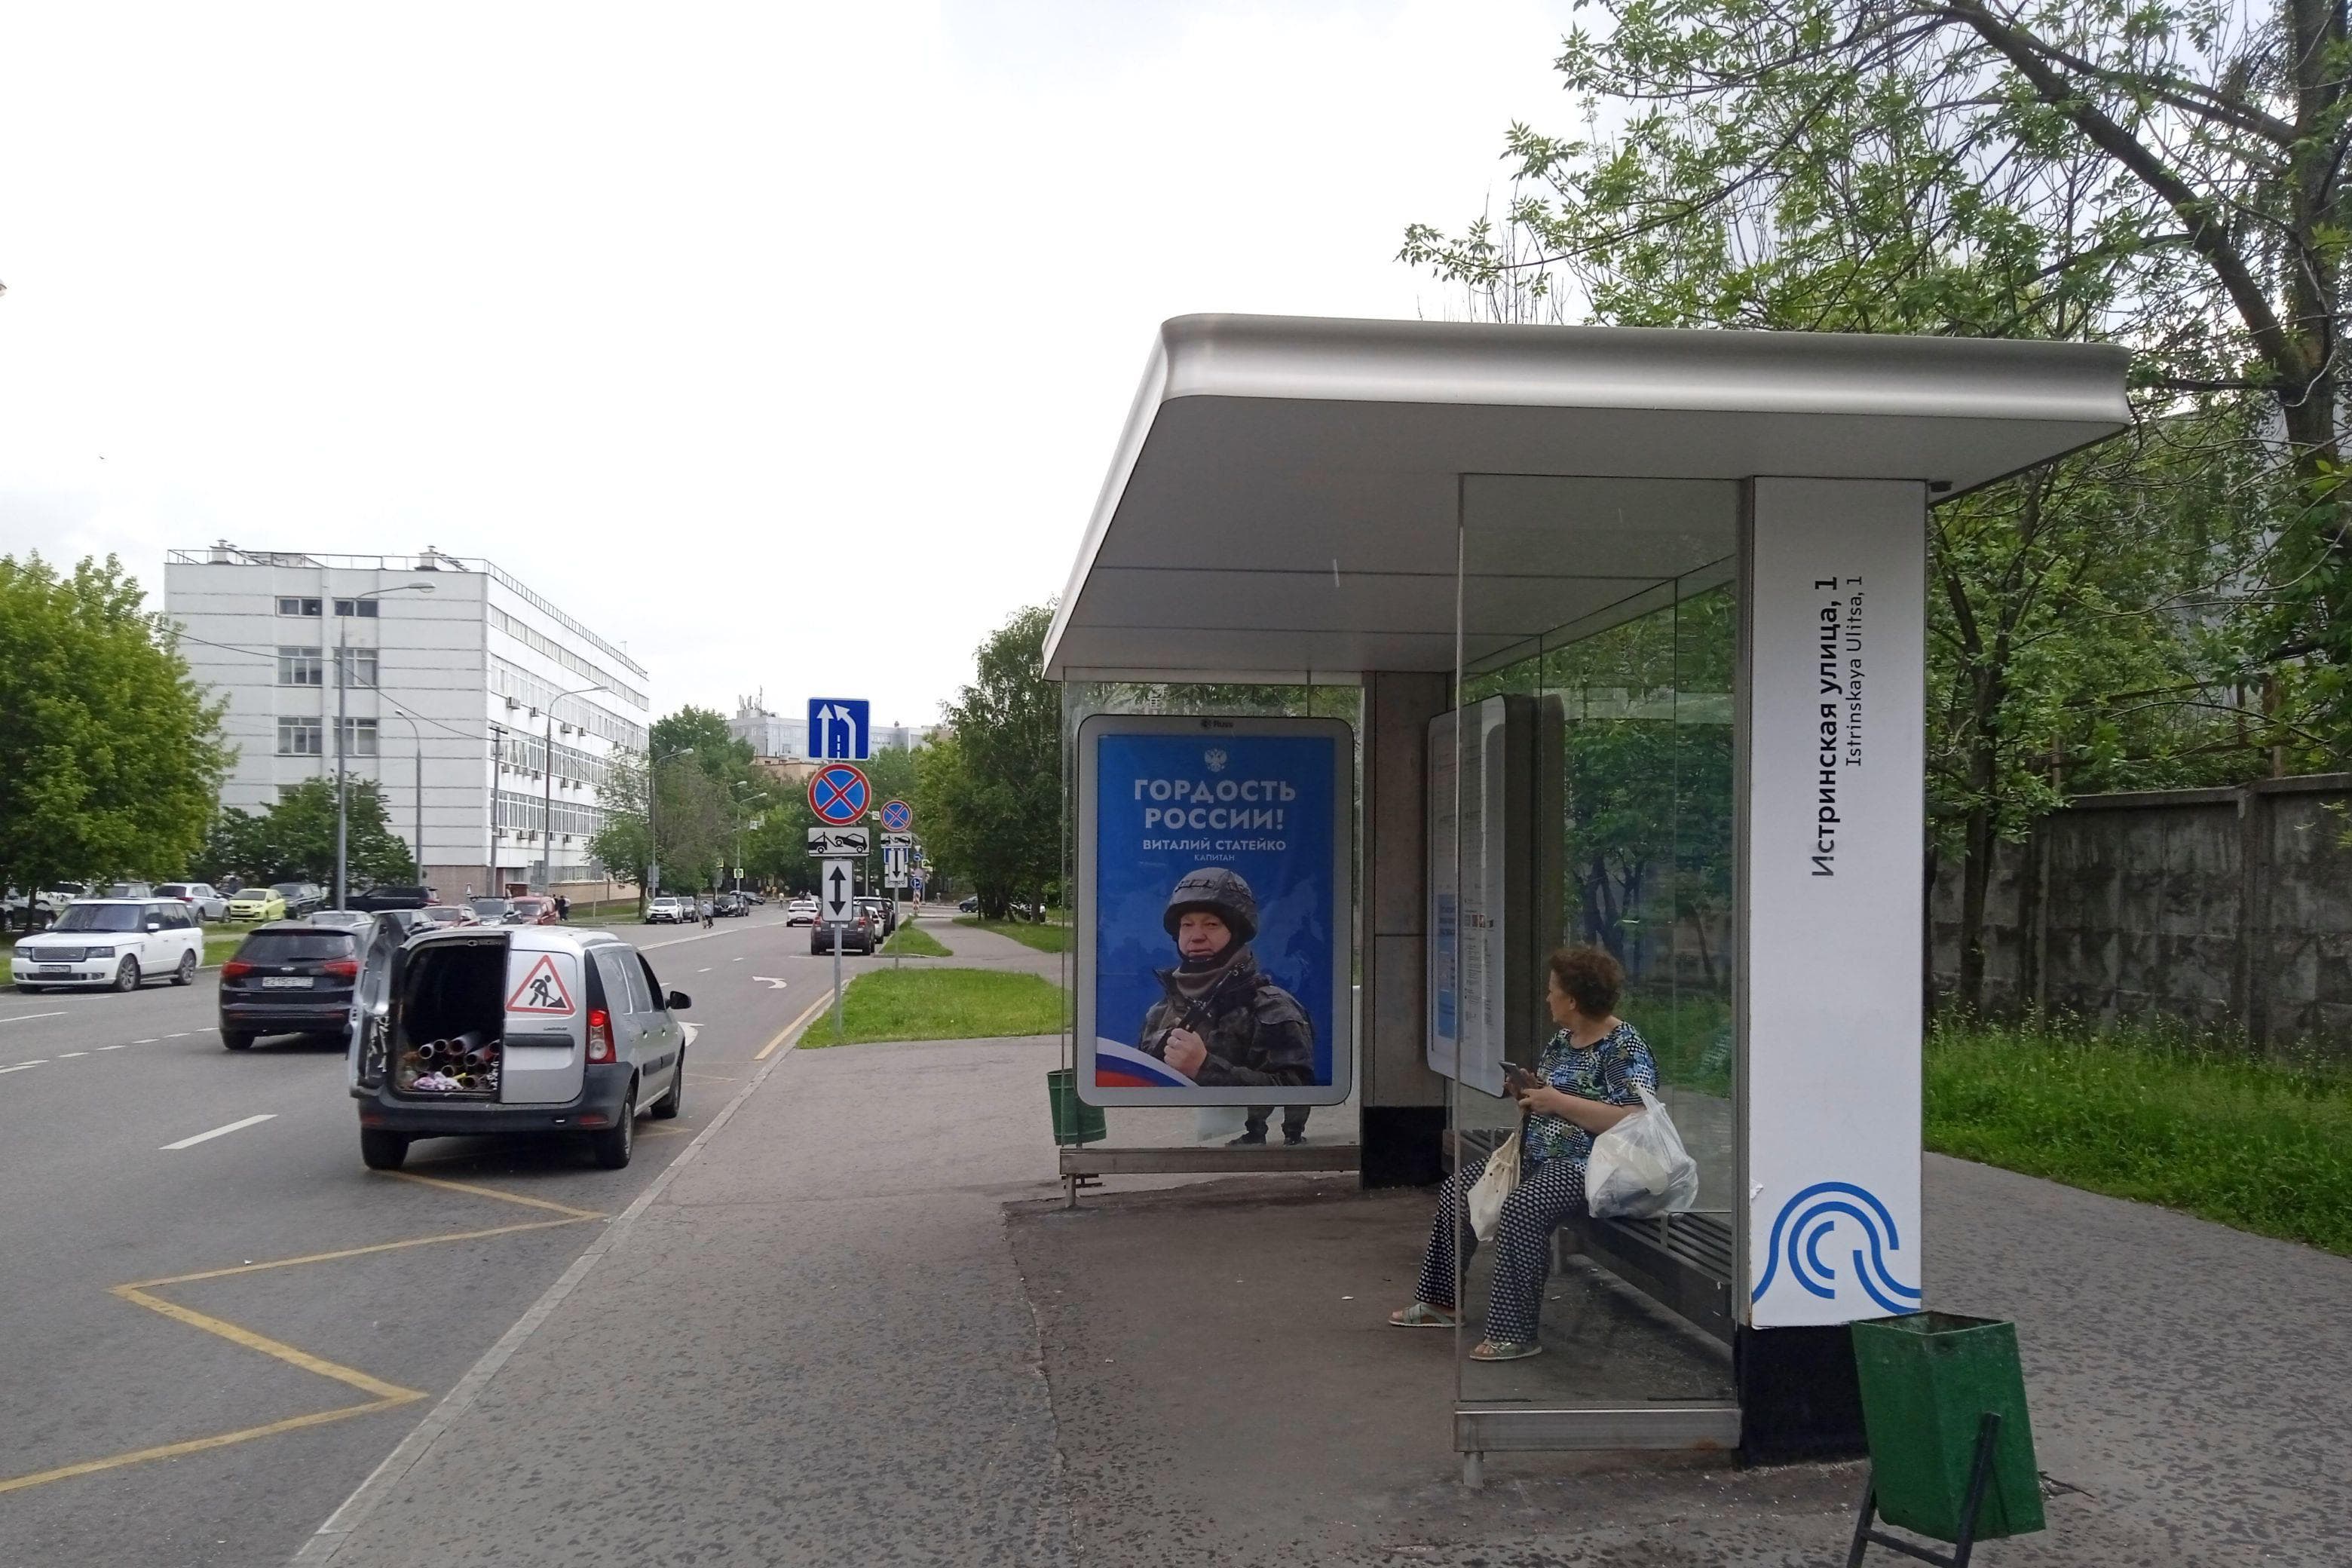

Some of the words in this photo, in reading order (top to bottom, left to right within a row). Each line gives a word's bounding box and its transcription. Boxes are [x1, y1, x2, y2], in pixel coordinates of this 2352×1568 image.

[1815, 577, 1837, 590] 1
[1846, 576, 1862, 586] 1
[1845, 592, 1865, 651] Ulitsa,
[1821, 601, 1842, 695] улица,
[1845, 659, 1865, 766] Istrinskaya
[1135, 779, 1296, 804] ГОРДОСТЬ
[1811, 703, 1841, 876] Истринская
[1145, 808, 1284, 829] РОССИИ!
[1143, 837, 1210, 850] ВИТАЛИЙ
[1215, 838, 1286, 850] СТАТЕЙКО
